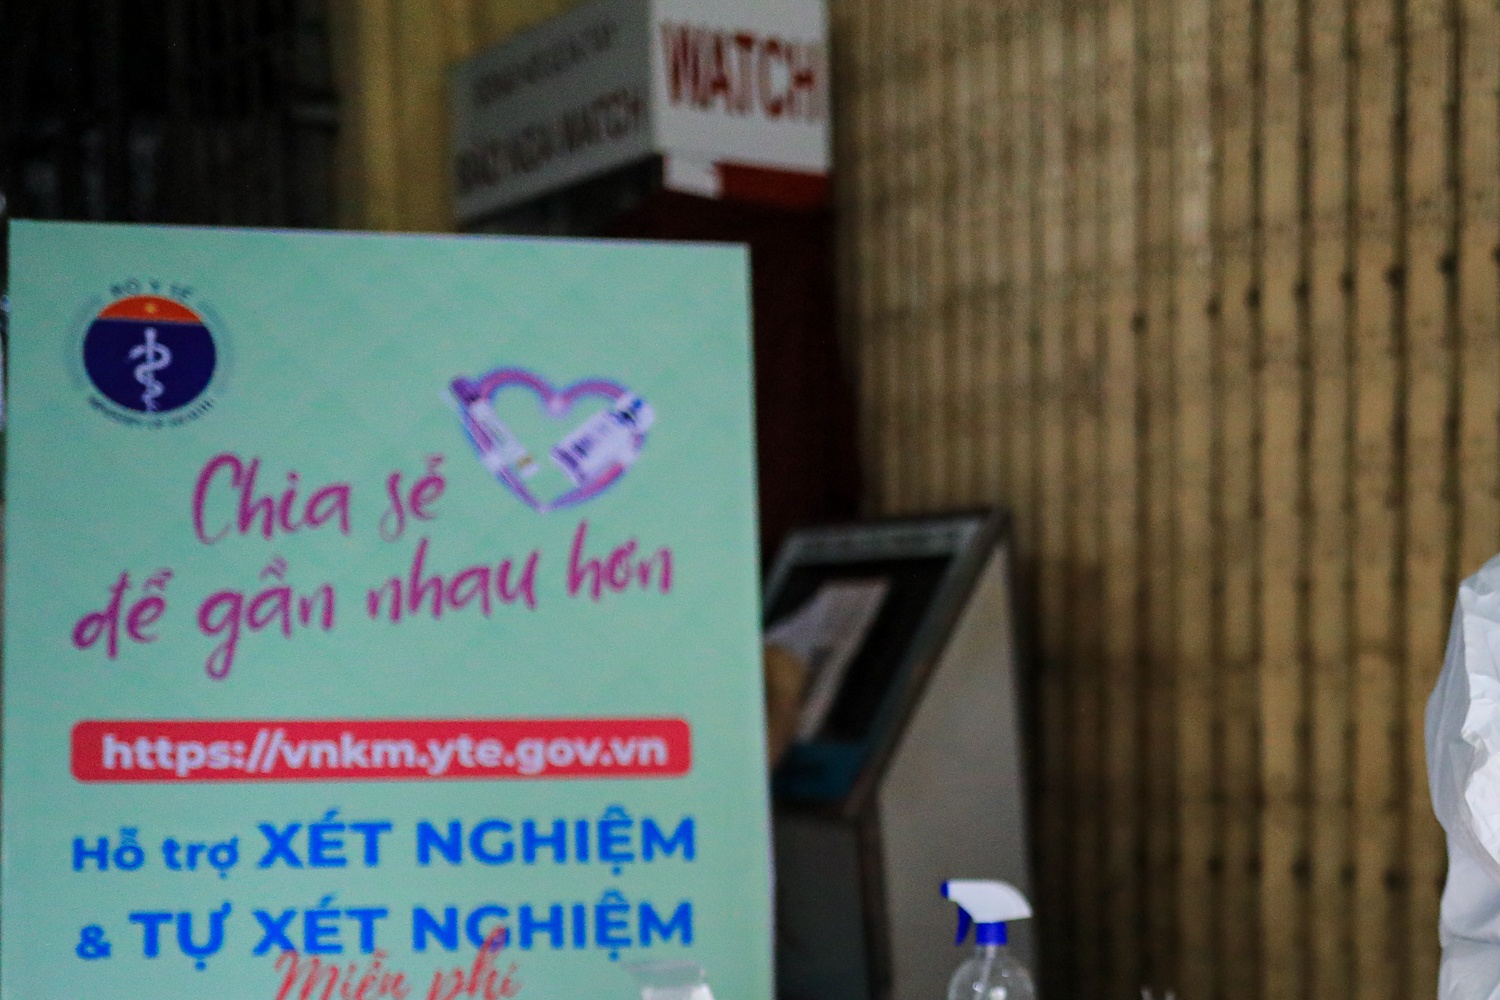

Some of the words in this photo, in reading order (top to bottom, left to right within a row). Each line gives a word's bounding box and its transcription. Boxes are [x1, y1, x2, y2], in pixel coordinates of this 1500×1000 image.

[661, 20, 826, 122] WATCH
[191, 451, 353, 545] Chia
[378, 453, 446, 542] sẻ
[71, 567, 175, 661] để
[196, 554, 336, 681] gần
[366, 536, 543, 625] nhau
[565, 517, 674, 602] hơn
[102, 728, 669, 777] https://vnkm.yte.gov.vn
[72, 826, 145, 873] Hỗ
[162, 834, 239, 880] trợ
[256, 808, 393, 869] XÉT
[416, 804, 696, 876] NGHIỆM
[75, 924, 112, 960] &
[128, 901, 233, 971] TỰ
[252, 894, 390, 957] XÉT
[411, 888, 693, 961] NGHIỆM
